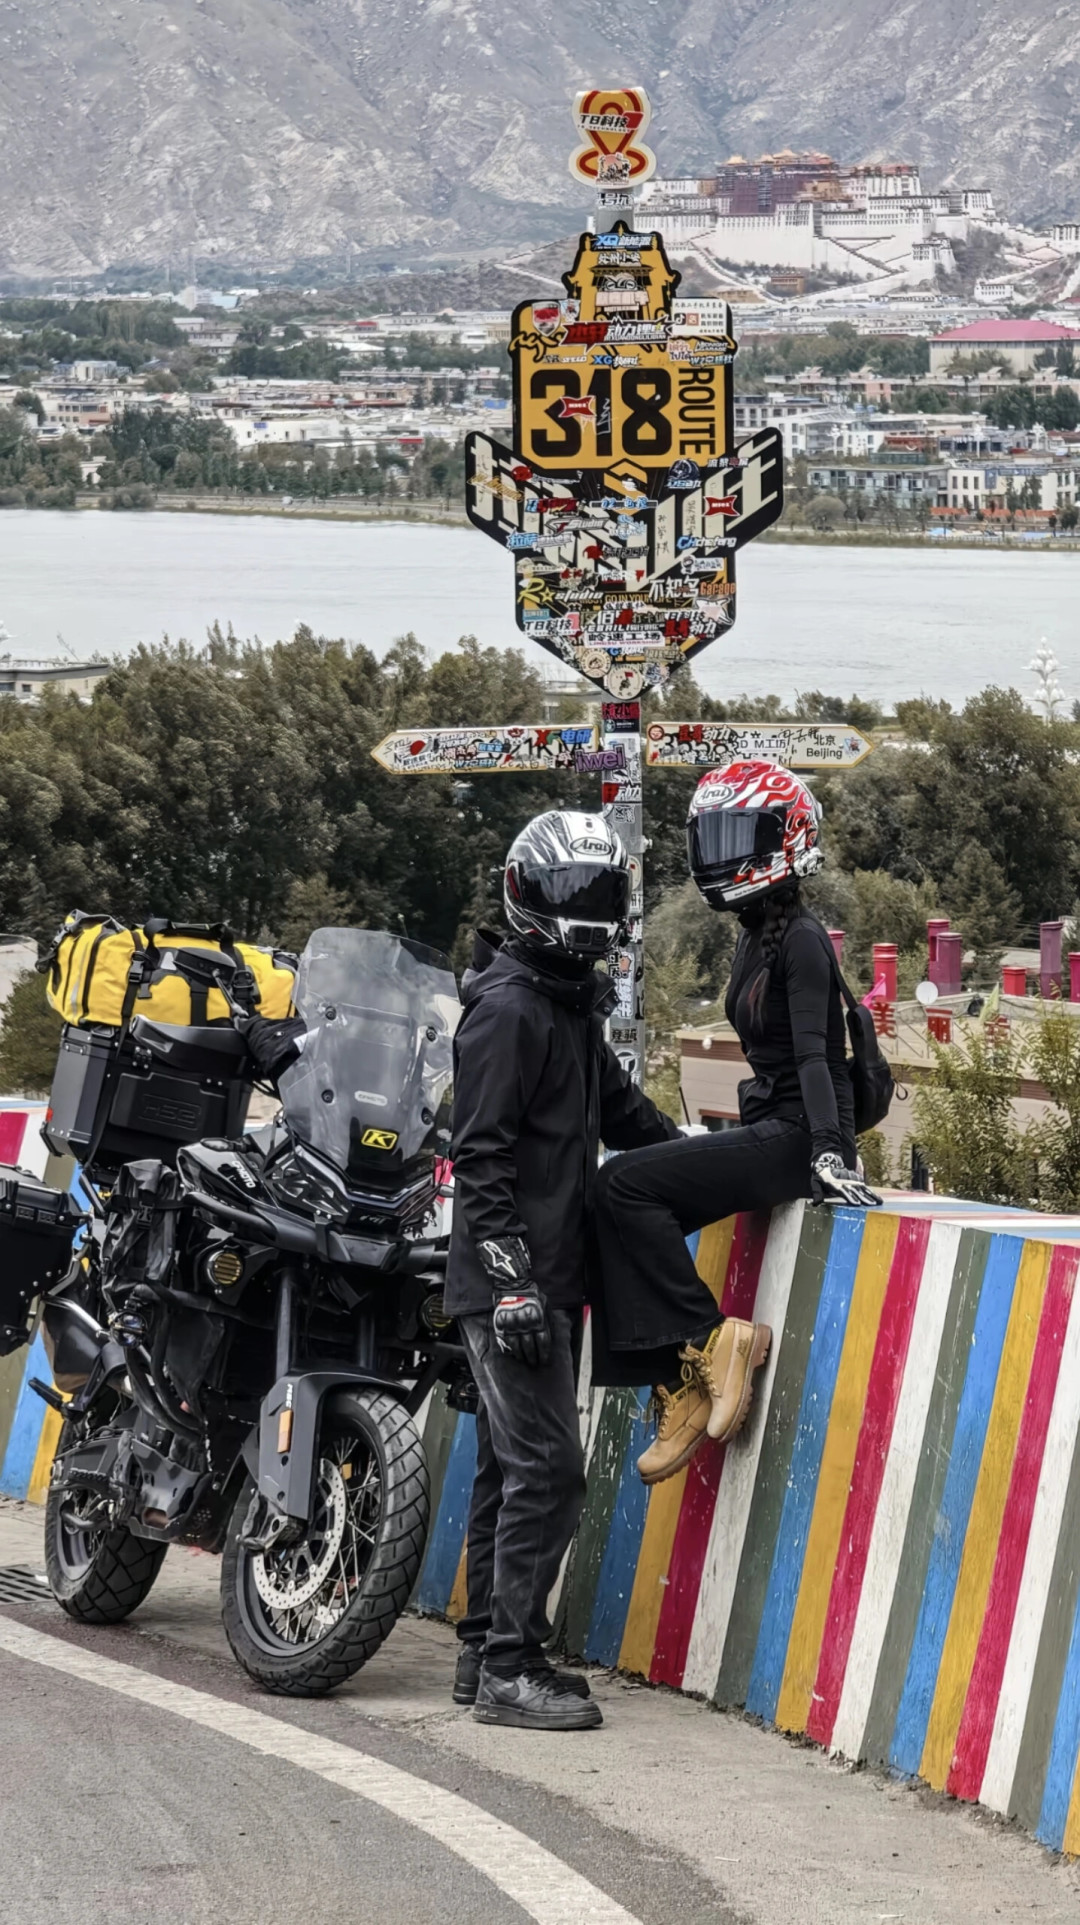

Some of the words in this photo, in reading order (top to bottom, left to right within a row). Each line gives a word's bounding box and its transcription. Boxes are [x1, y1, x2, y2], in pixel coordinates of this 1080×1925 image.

[579, 114, 628, 128] TB科技
[530, 367, 672, 458] 318
[678, 367, 716, 456] ROUTE
[814, 734, 836, 746] 北京
[806, 747, 843, 760] Beijing
[701, 786, 727, 800] Arai
[574, 838, 609, 851] Arai
[366, 1131, 394, 1147] K
[231, 1160, 256, 1189] CFMOTO
